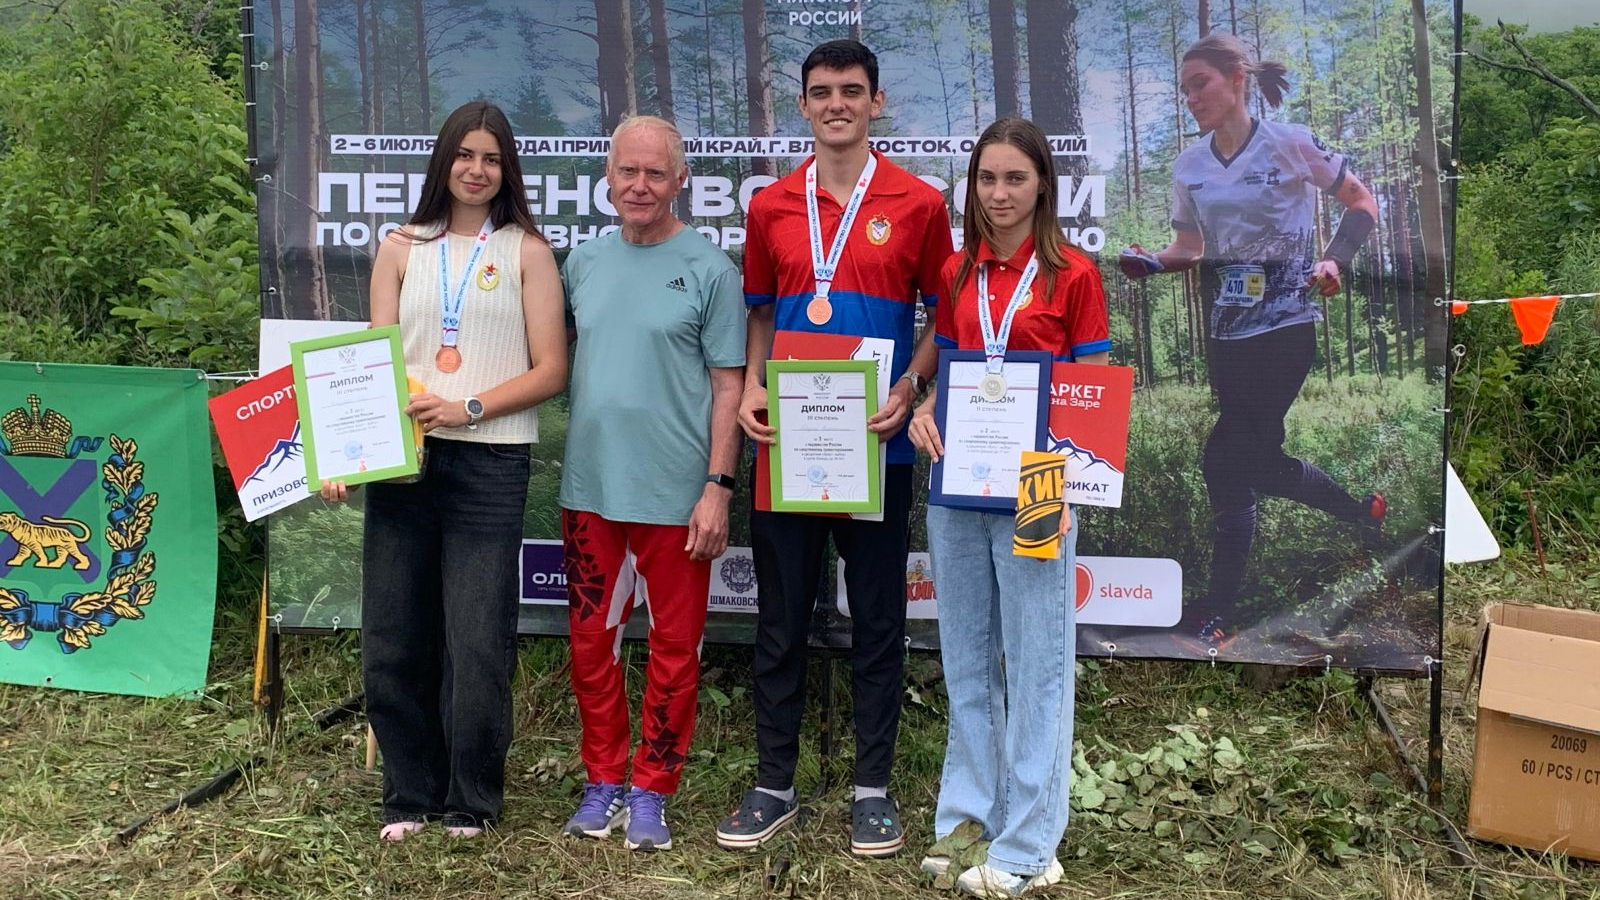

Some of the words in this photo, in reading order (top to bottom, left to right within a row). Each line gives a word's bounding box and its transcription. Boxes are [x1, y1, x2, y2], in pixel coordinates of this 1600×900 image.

[788, 11, 862, 26] РОССИИ
[380, 138, 438, 152] ИЮЛЯ
[706, 137, 766, 156] КРАЙ,
[316, 221, 371, 247] ПО
[329, 374, 374, 389] ДИПЛОМ
[236, 384, 297, 421] СПОРТ
[969, 395, 1016, 404] ДИОМ
[1051, 397, 1068, 406] на
[1069, 397, 1101, 411] Заре
[800, 404, 846, 414] ДИПЛОМ
[1100, 583, 1153, 599] slavda
[1551, 734, 1587, 754] 20069
[1521, 759, 1536, 775] 60
[1546, 763, 1573, 781] PCS
